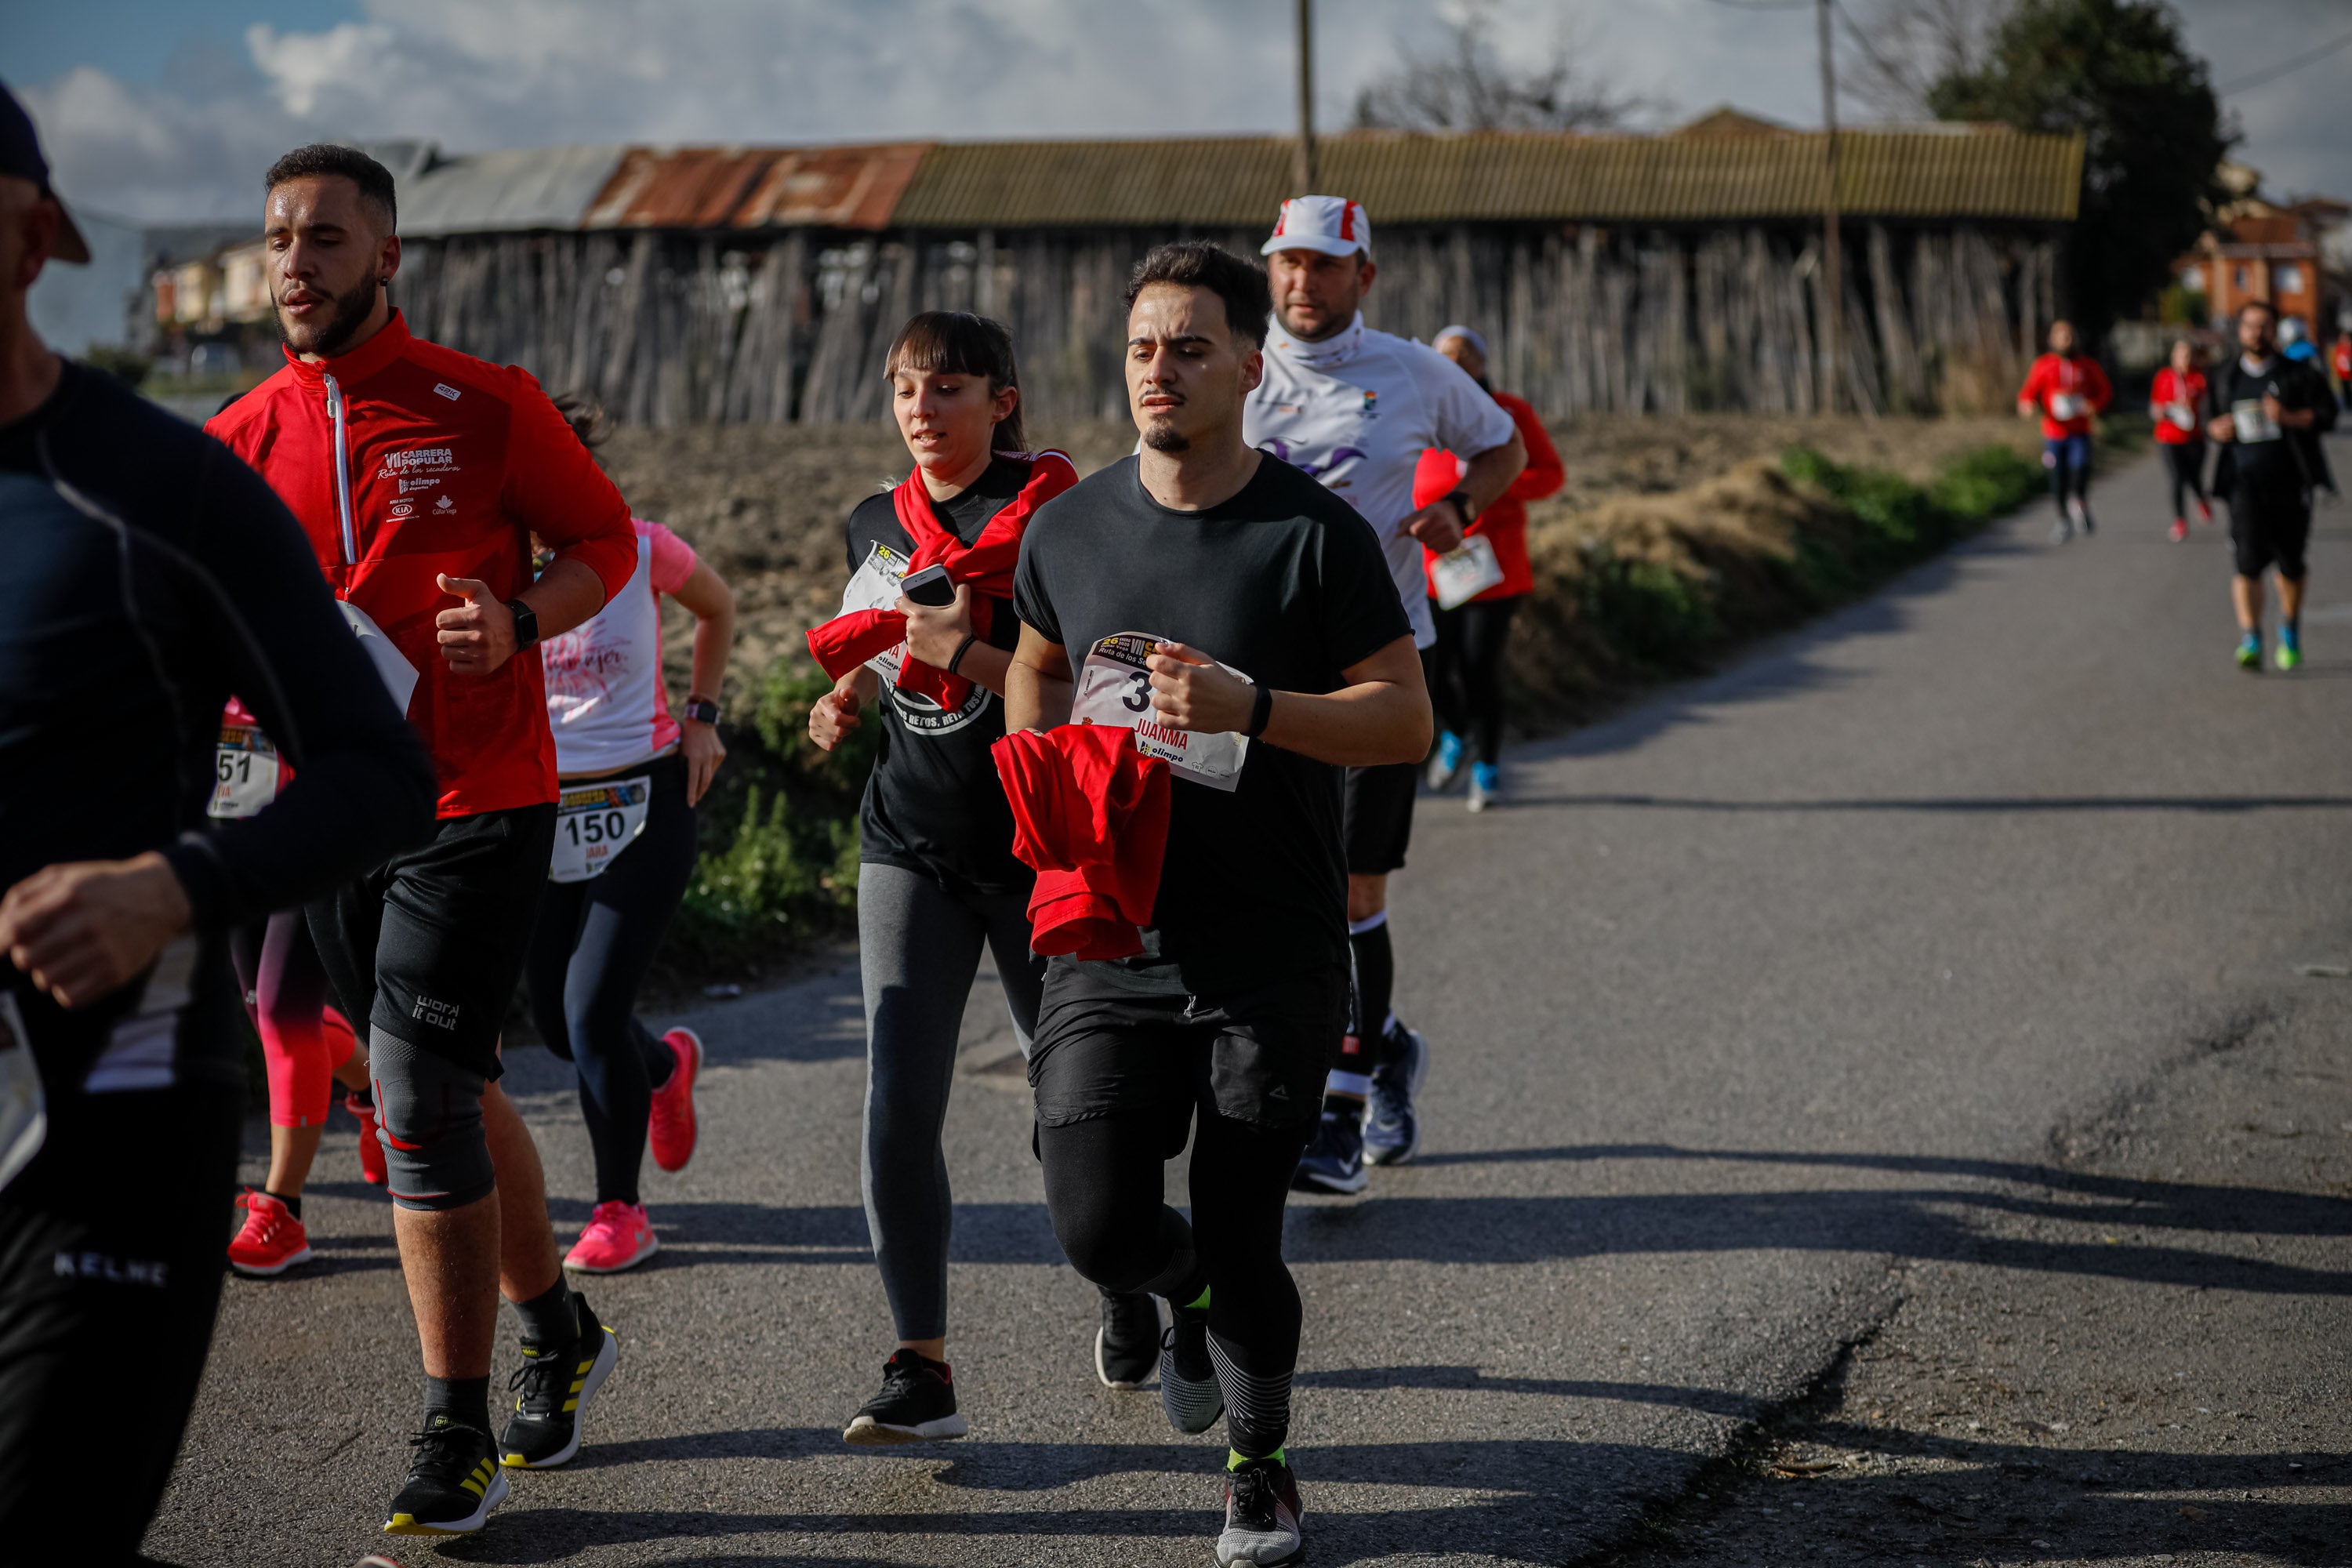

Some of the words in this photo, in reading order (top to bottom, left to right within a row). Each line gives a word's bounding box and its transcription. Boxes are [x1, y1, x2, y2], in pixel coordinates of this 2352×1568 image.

[437, 386, 457, 397] 42K
[385, 452, 401, 469] VII
[401, 448, 452, 459] CARRERA
[401, 456, 452, 466] POPULAR
[378, 469, 397, 479] Ruta
[400, 466, 409, 475] de
[412, 465, 423, 474] los
[426, 463, 461, 473] secaderos
[410, 477, 440, 486] olimpo
[878, 546, 891, 560] 26
[1102, 637, 1120, 646] 26
[1131, 638, 1145, 655] VII
[1126, 653, 1136, 662] los
[1123, 671, 1152, 712] 3
[909, 713, 940, 728] RETOS,
[1134, 718, 1188, 750] JUANMA
[1152, 747, 1184, 762] olimpo
[218, 753, 251, 784] 51
[565, 811, 625, 846] 150
[416, 995, 459, 1018] work
[412, 1004, 423, 1020] it
[426, 1012, 456, 1031] out
